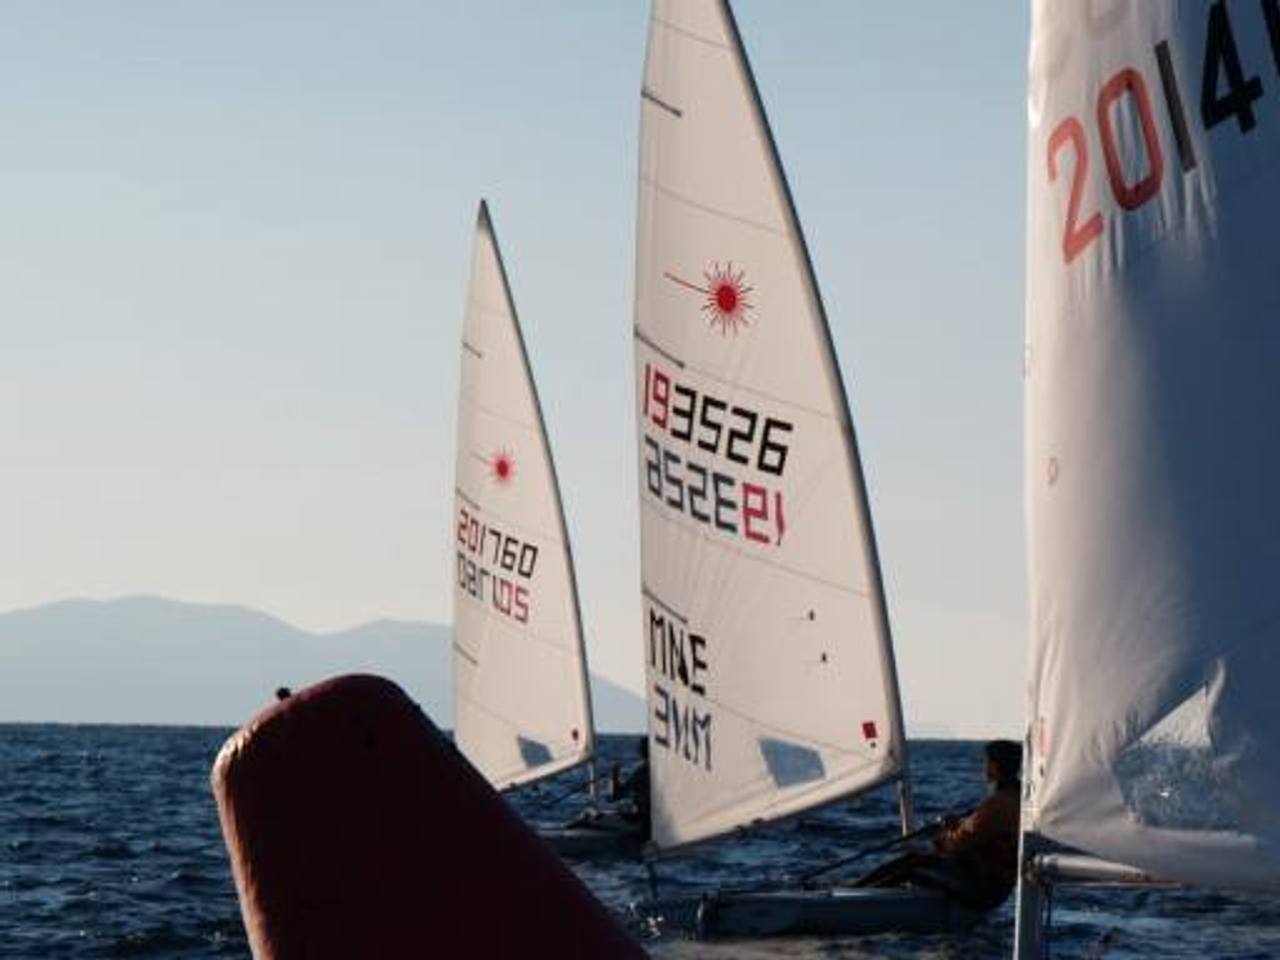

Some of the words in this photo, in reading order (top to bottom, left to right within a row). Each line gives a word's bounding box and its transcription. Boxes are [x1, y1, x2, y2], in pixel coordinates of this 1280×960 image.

[644, 363, 793, 476] 193526
[457, 508, 538, 578] 201760
[650, 608, 708, 696] MNE
